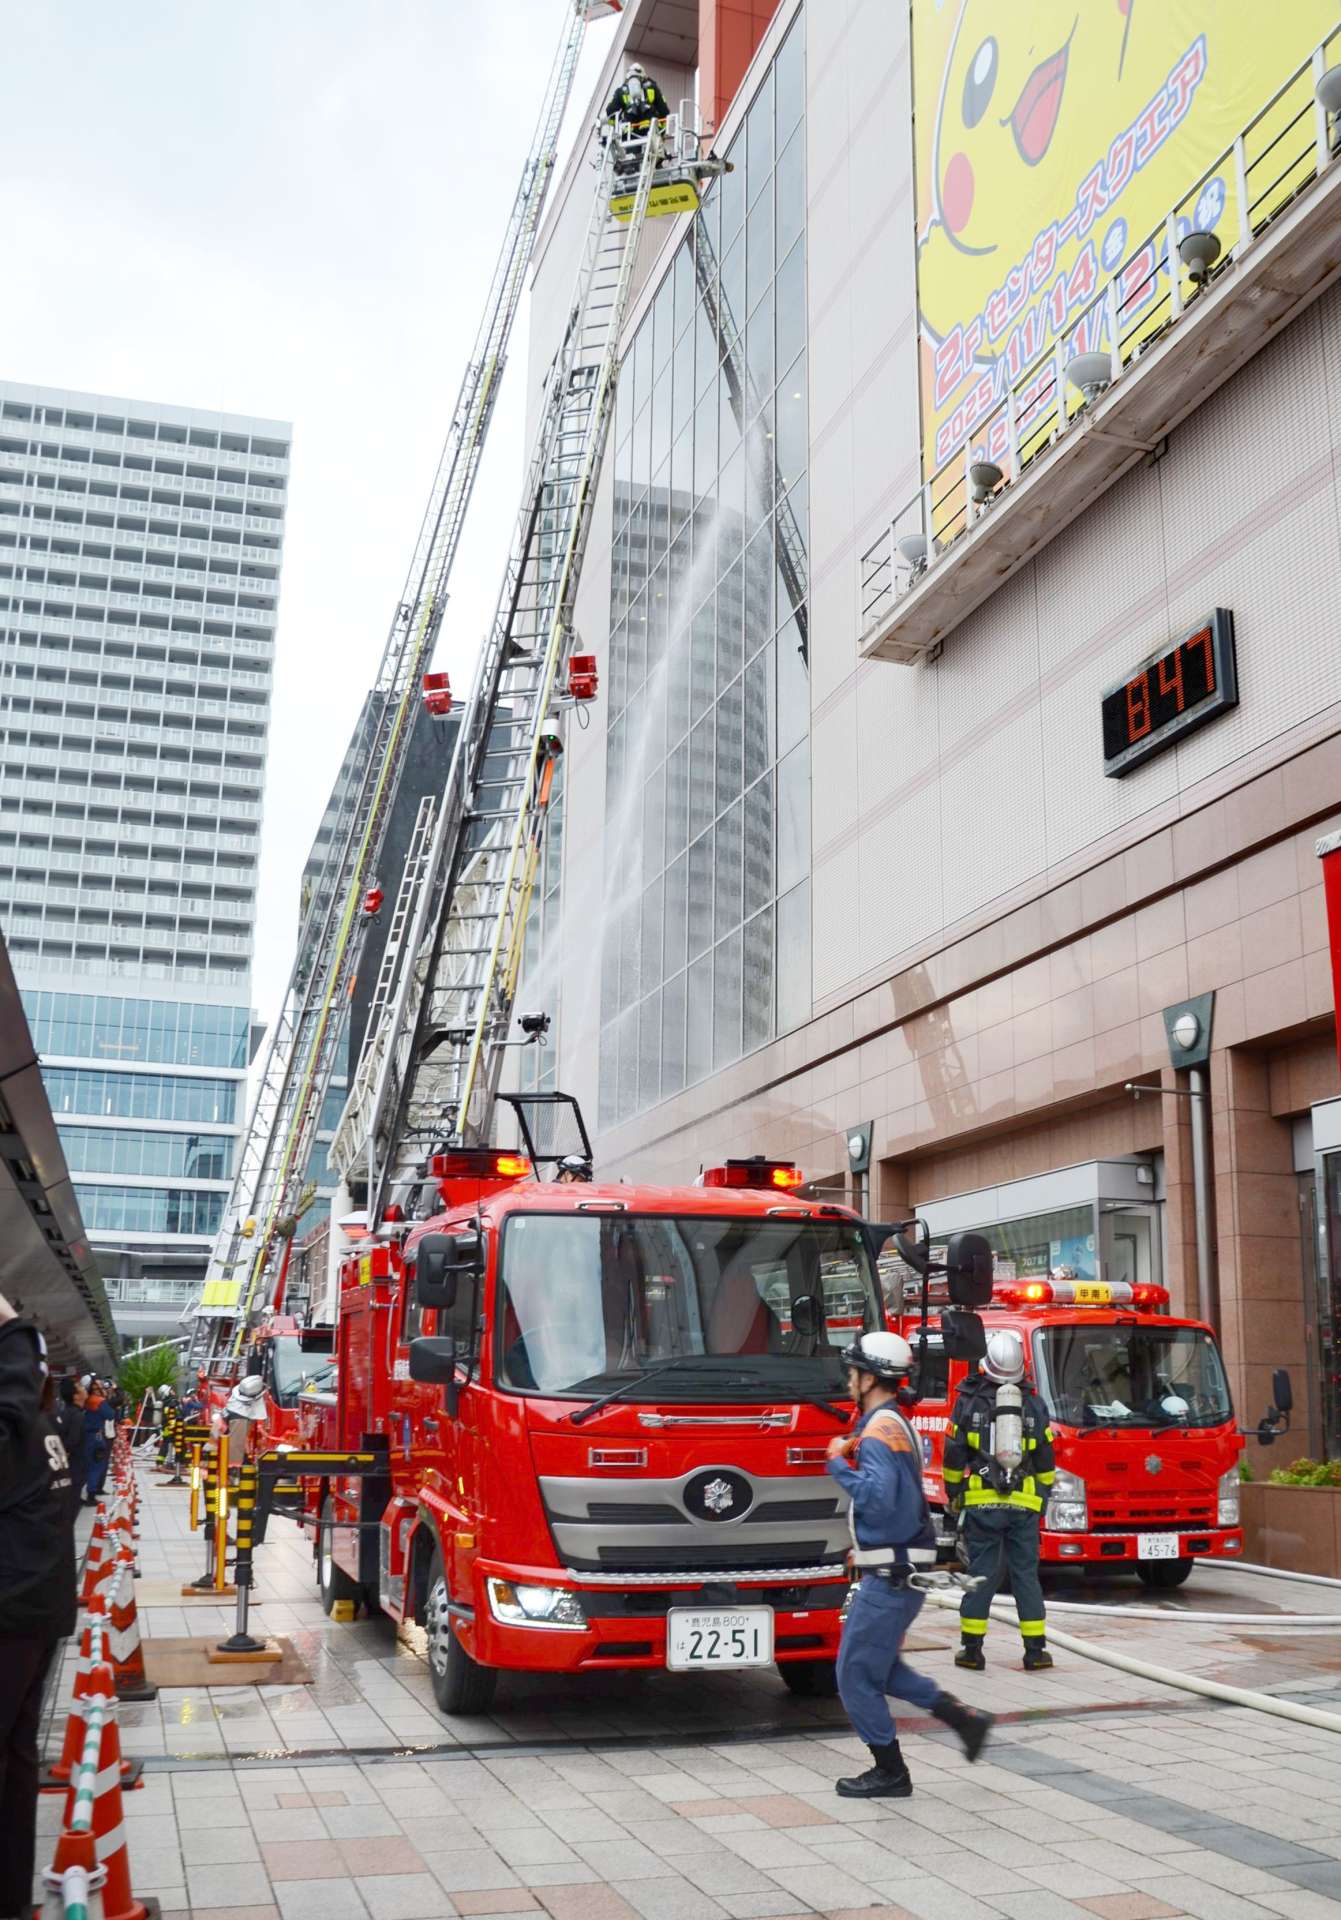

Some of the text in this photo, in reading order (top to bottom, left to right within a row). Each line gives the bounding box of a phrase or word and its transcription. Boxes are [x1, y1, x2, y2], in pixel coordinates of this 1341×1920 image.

[985, 36, 1206, 342] センタースクエア
[689, 1628, 758, 1659] 22-51
